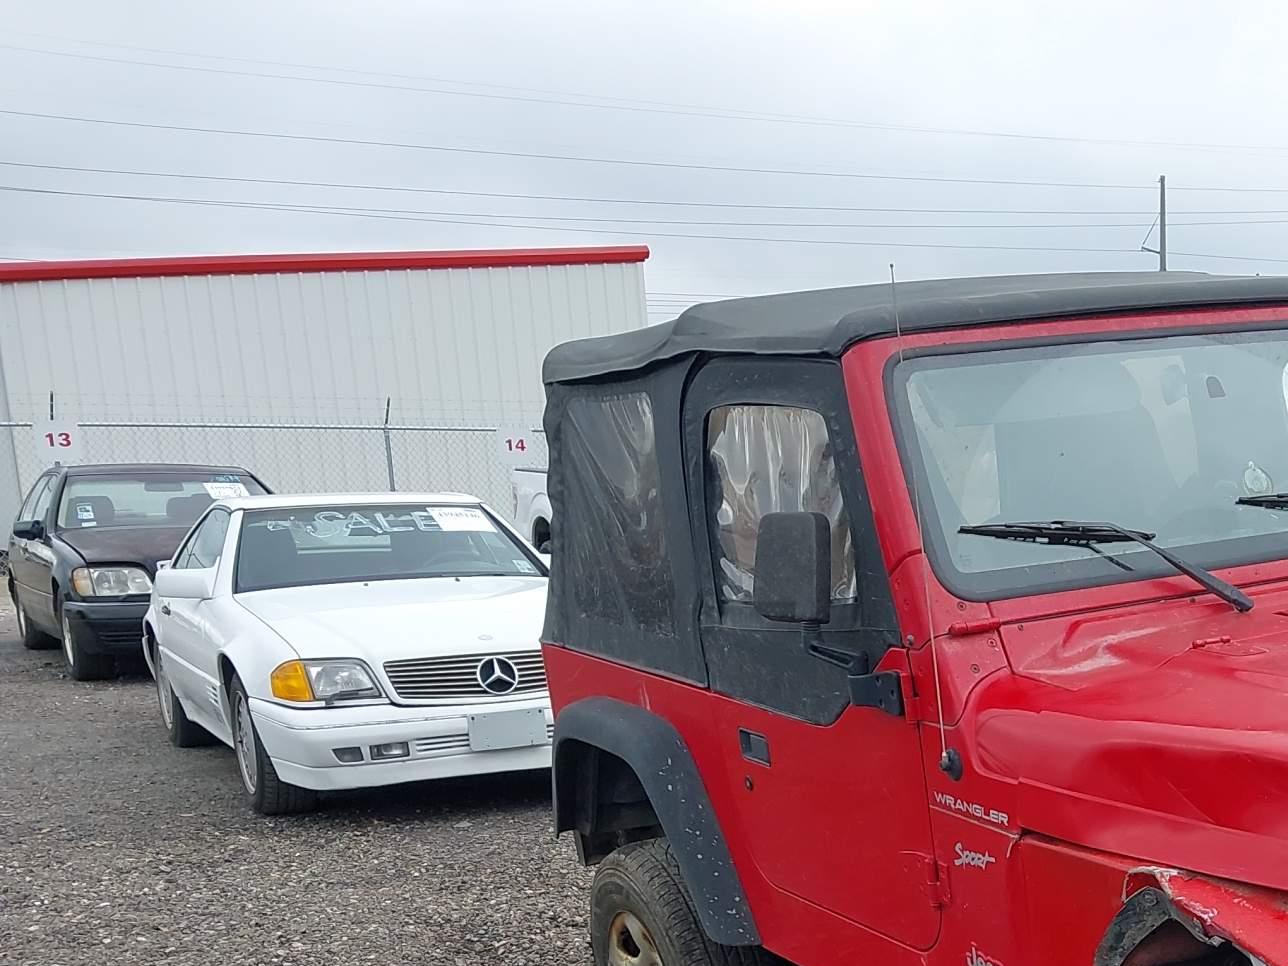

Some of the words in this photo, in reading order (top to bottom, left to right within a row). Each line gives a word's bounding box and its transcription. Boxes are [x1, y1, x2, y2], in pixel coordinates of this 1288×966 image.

[46, 433, 71, 446] 13
[505, 433, 526, 451] 14
[306, 511, 441, 537] SALE
[934, 791, 1008, 825] WRANGLER
